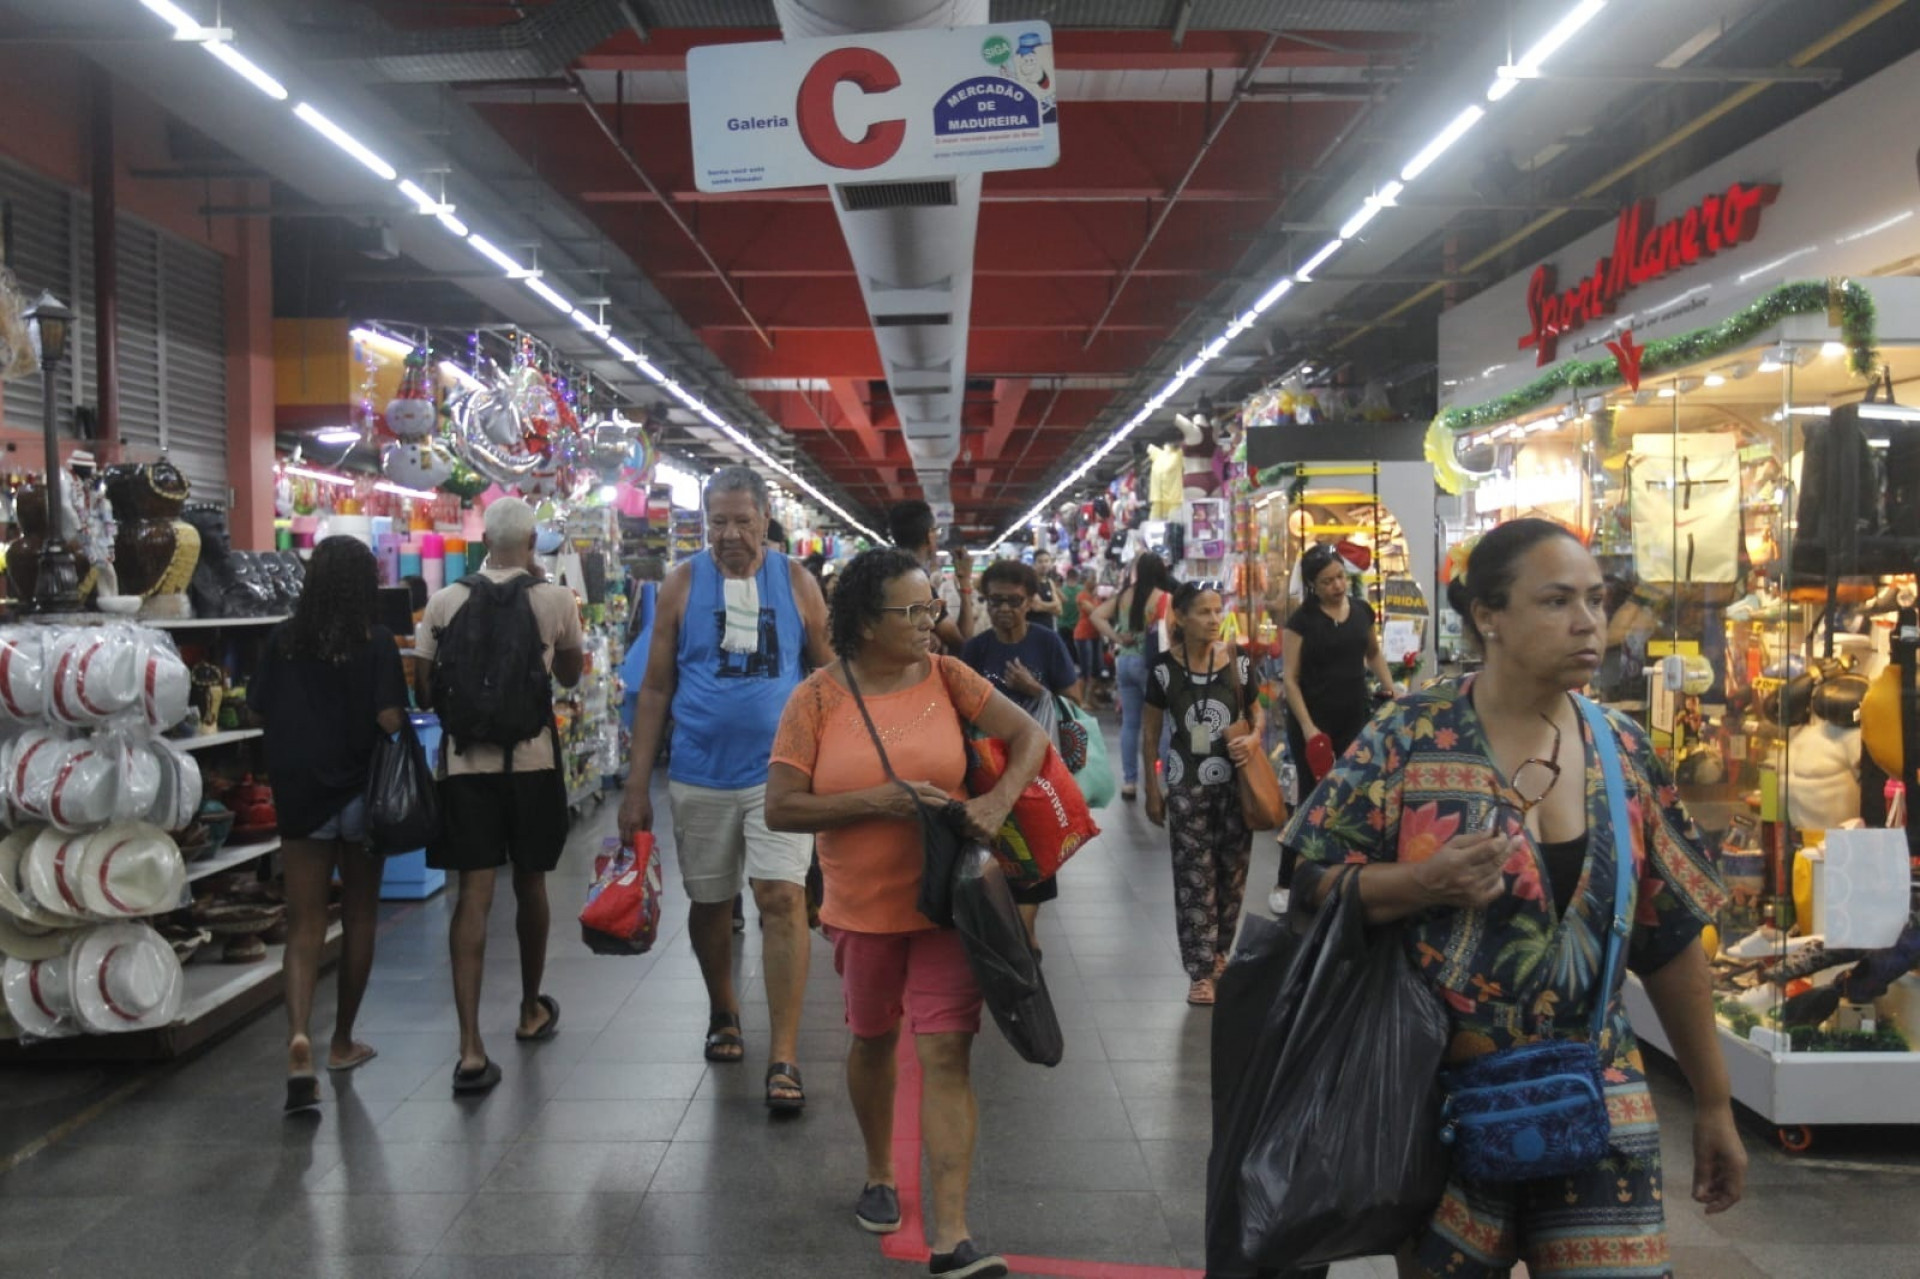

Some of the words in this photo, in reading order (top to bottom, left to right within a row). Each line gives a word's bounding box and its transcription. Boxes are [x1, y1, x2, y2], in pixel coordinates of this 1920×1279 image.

[984, 42, 1010, 58] SIGA
[947, 84, 1024, 107] MERCADÃO
[727, 115, 788, 131] Galeria
[796, 47, 906, 170] C
[977, 101, 996, 111] DE
[948, 115, 1028, 130] MADUREIRA
